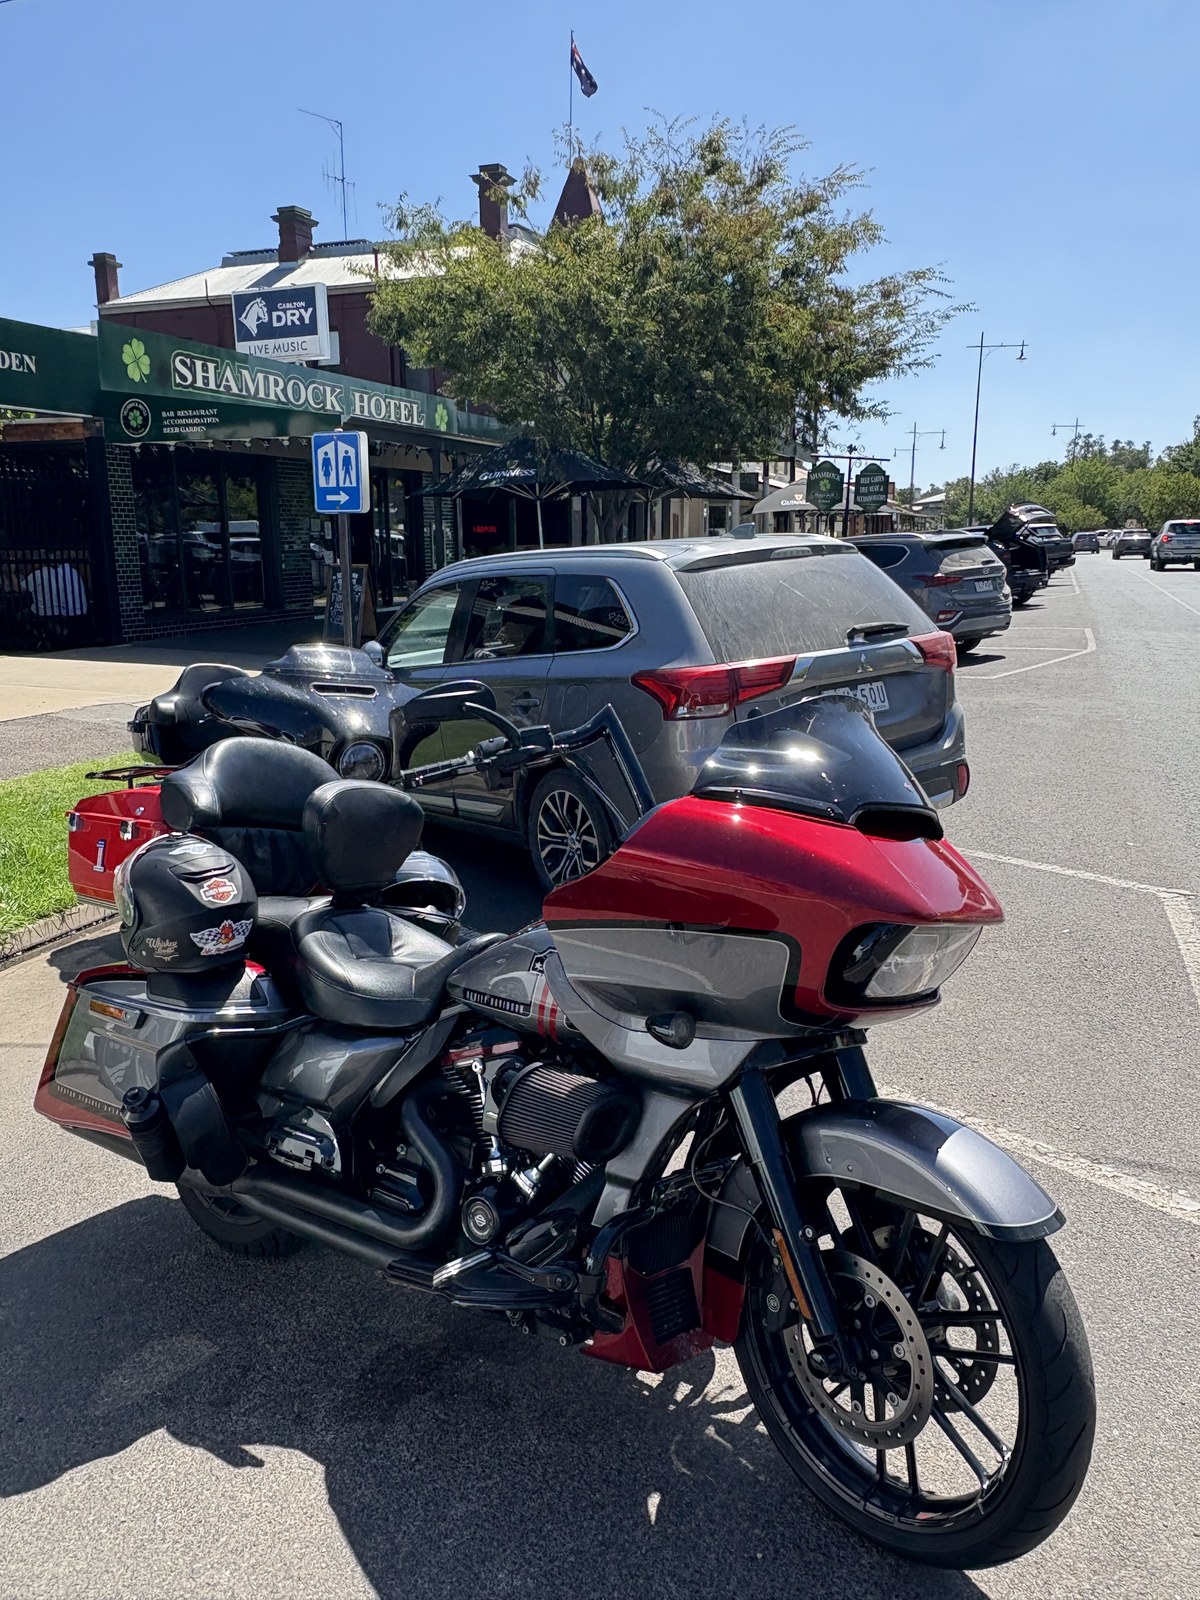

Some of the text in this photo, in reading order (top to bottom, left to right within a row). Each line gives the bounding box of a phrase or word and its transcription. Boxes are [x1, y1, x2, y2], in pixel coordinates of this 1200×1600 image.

[277, 301, 306, 310] CARLTON
[271, 307, 313, 328] DRY
[248, 340, 308, 356] LIVE MUSIC
[174, 356, 424, 426] SHAMROCK HOTEL
[176, 408, 218, 417] RESTAURANT
[162, 417, 220, 426] ACCOMMODATION
[180, 425, 207, 433] GARDEN
[478, 468, 537, 481] GUINNESS
